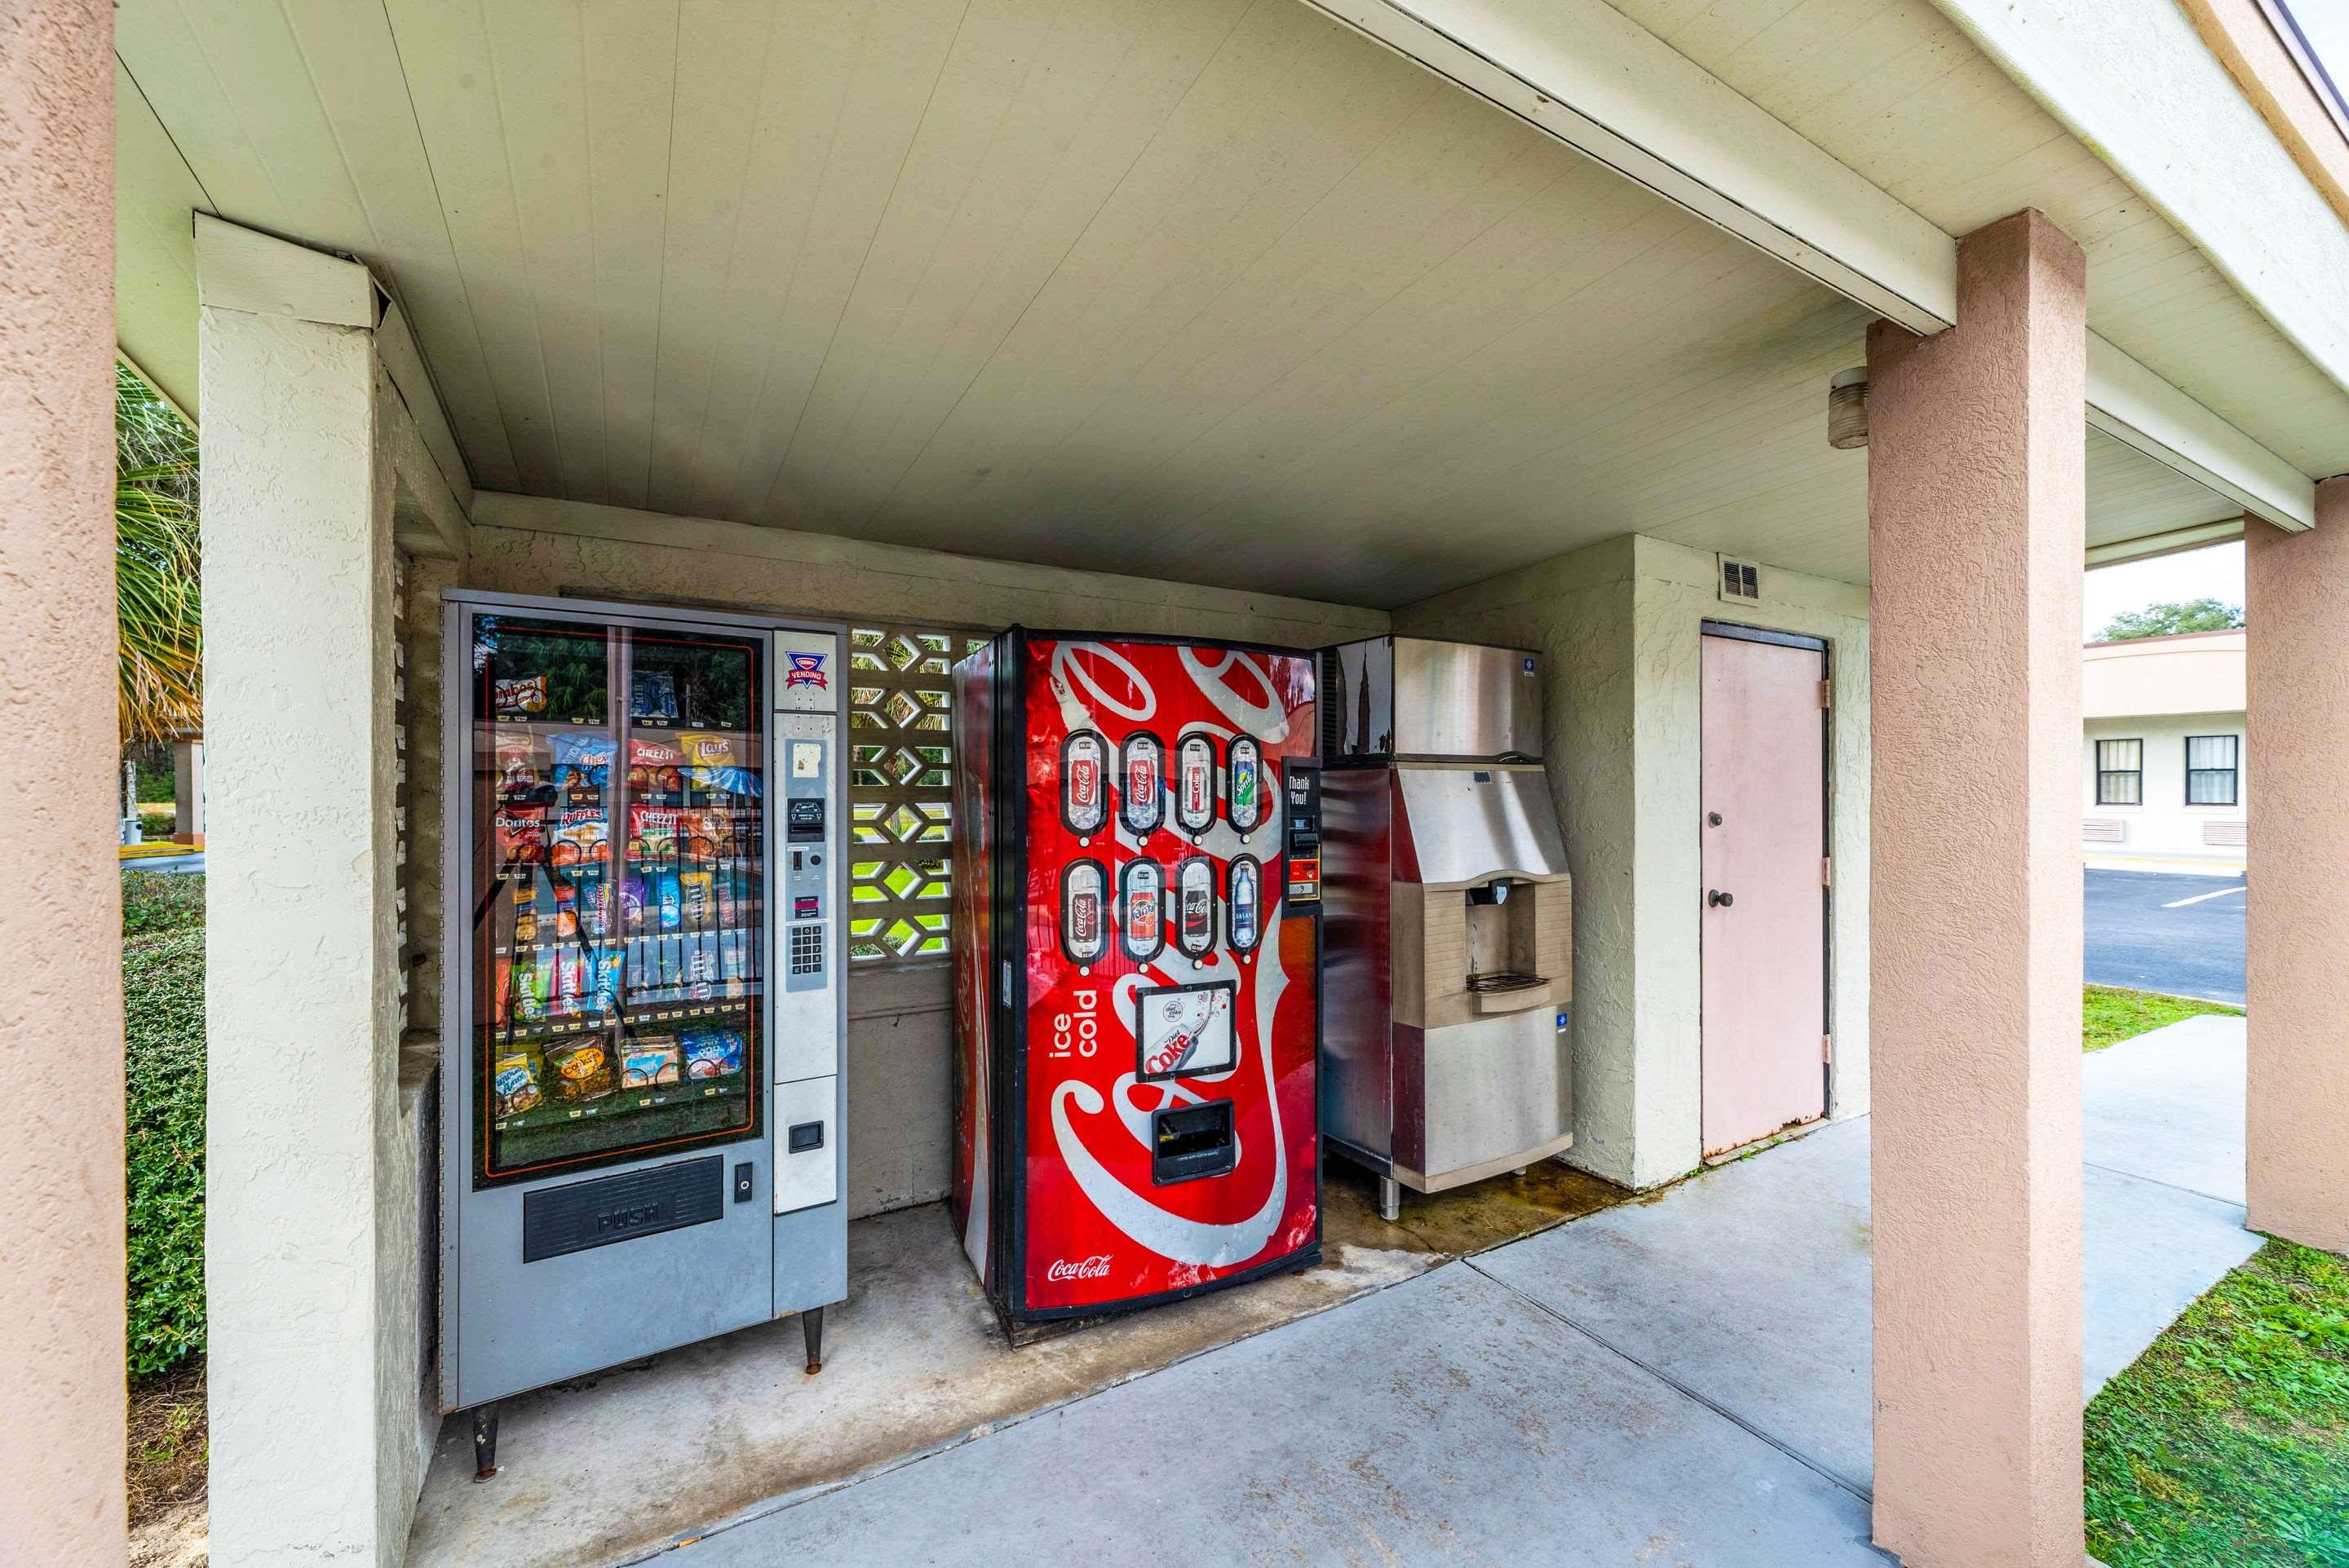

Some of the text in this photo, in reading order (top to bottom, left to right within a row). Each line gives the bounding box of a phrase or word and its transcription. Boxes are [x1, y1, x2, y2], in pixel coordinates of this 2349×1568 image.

[791, 670, 822, 680] VENDING
[579, 754, 608, 765] Chex
[1077, 764, 1089, 802] Coca-Cola
[1135, 763, 1147, 802] Coca-Cola
[1236, 773, 1253, 797] Sprite
[1289, 776, 1309, 789] Thank
[1290, 791, 1307, 805] You!
[496, 817, 540, 828] Doritos
[561, 808, 603, 826] RUFFLES
[1075, 898, 1087, 937] Coca-Cola
[1132, 904, 1154, 919] Fanta
[596, 960, 612, 1011] Skittles
[1049, 1014, 1072, 1058] ice
[1073, 989, 1097, 1058] cold
[1145, 1034, 1191, 1075] Coke
[598, 1201, 659, 1235] PUSH
[1047, 1254, 1114, 1282] Coca-Cola
